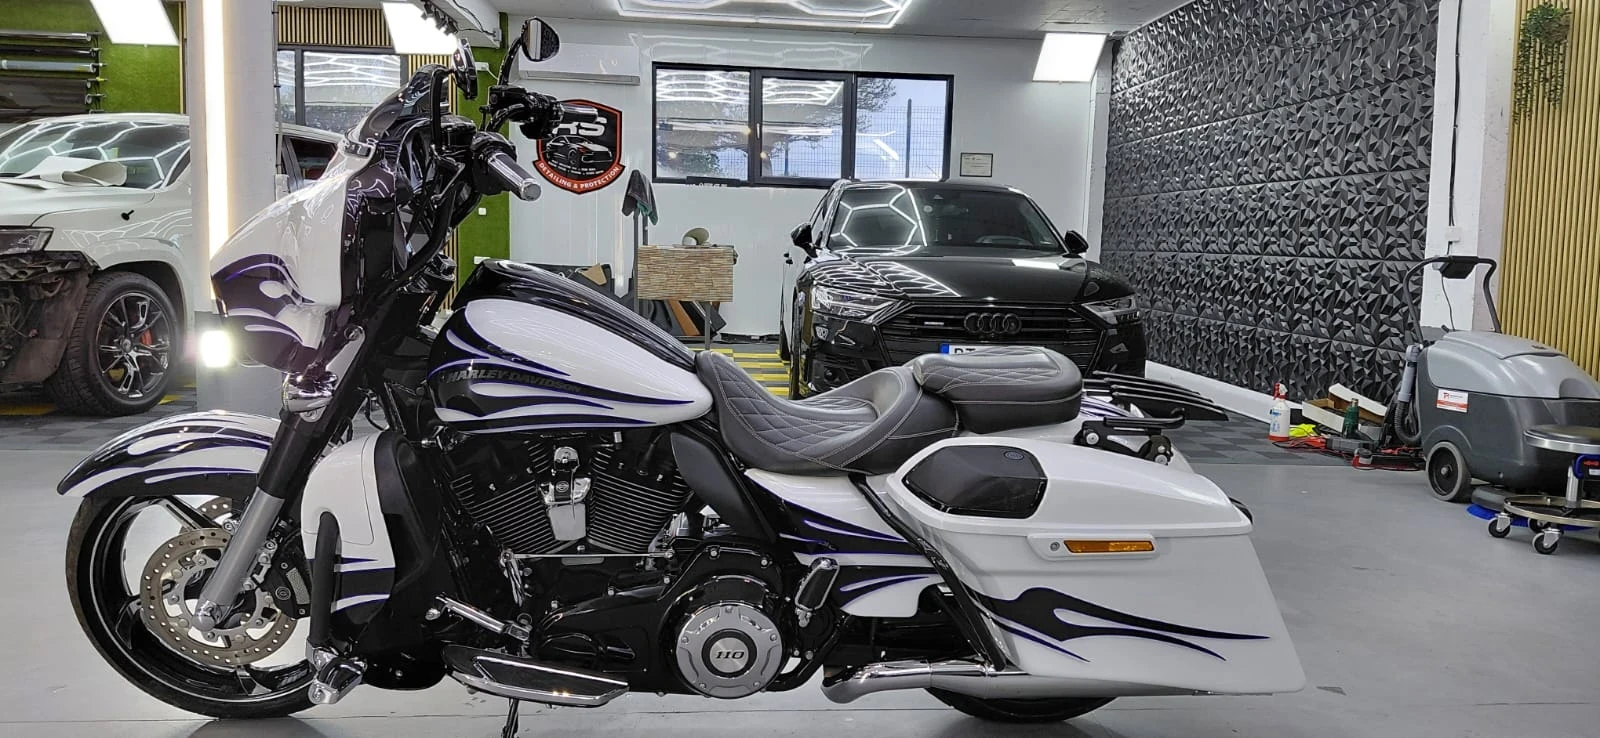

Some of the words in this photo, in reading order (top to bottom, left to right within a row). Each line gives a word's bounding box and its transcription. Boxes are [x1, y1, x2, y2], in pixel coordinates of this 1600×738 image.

[539, 163, 571, 187] DETAILING
[580, 167, 620, 189] PROTECTION
[447, 369, 581, 392] HARLEY-DAVIDSON
[716, 651, 745, 659] 110
